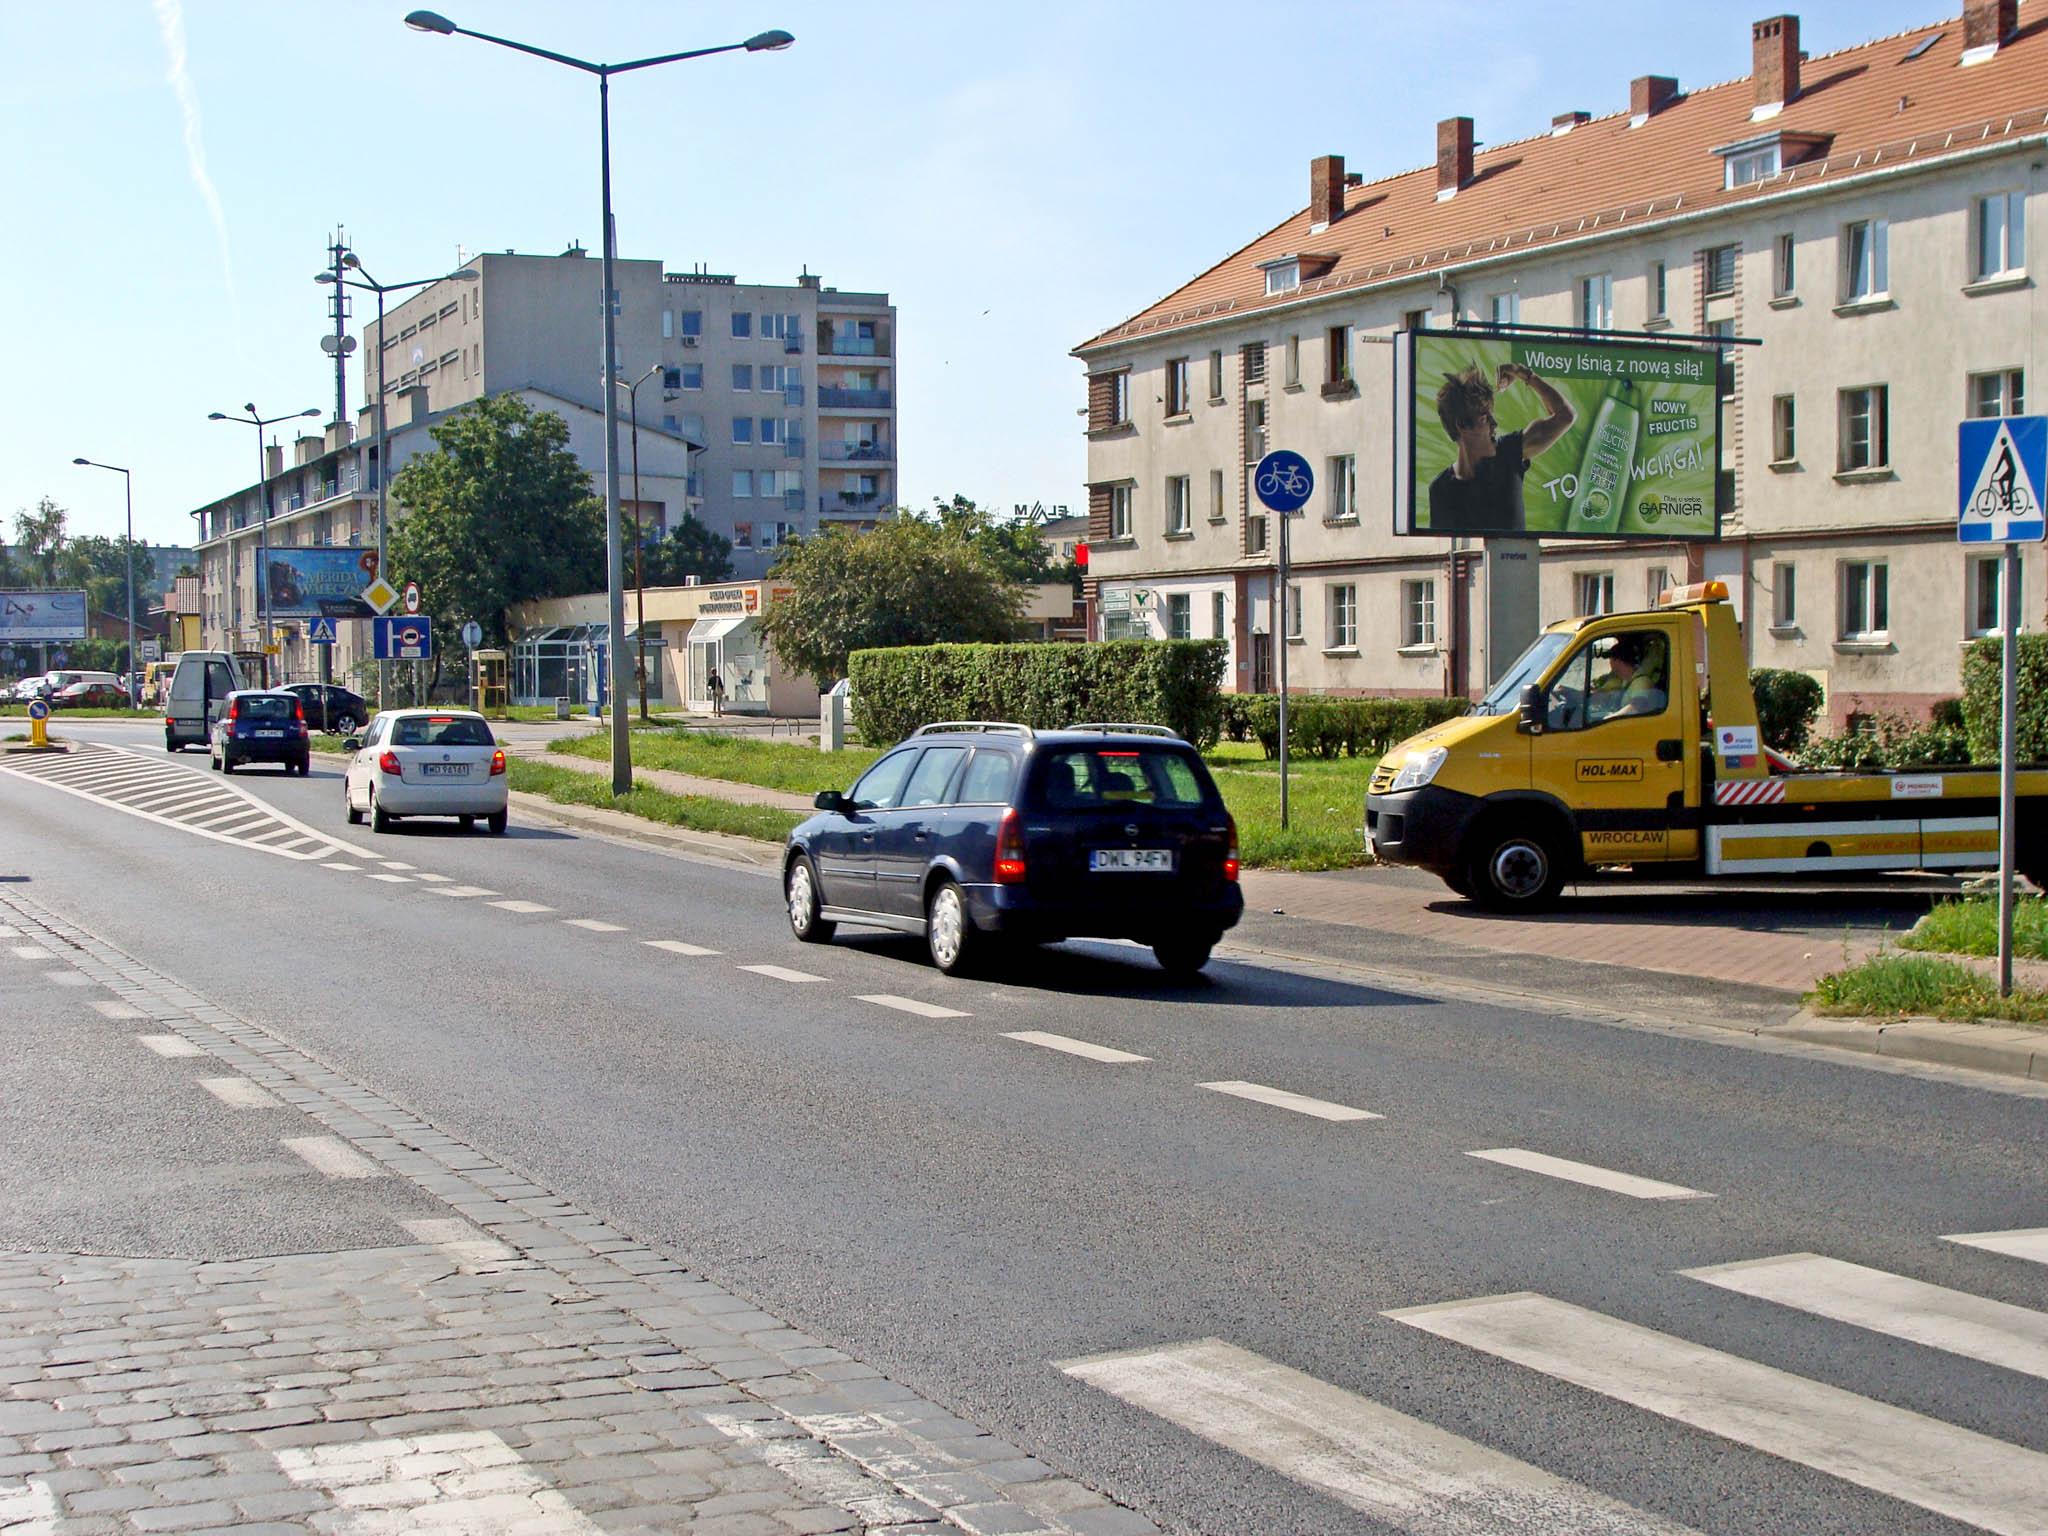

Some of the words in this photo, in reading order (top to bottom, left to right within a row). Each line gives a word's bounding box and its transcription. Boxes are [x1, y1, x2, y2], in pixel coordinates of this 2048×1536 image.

[1524, 350, 1572, 373] Włosy
[1577, 353, 1612, 376] lśnią
[1616, 360, 1625, 373] z
[1629, 360, 1671, 379] nową
[1674, 360, 1704, 380] siłą!
[1653, 401, 1687, 414] NOWY
[1648, 417, 1697, 435] FRUCTIS
[1542, 473, 1578, 503] TO
[1629, 441, 1705, 481] WCIĄGA!
[1638, 502, 1703, 516] GARNIER
[1581, 764, 1639, 776] HOL-MAX
[1589, 832, 1665, 844] WROCŁAW
